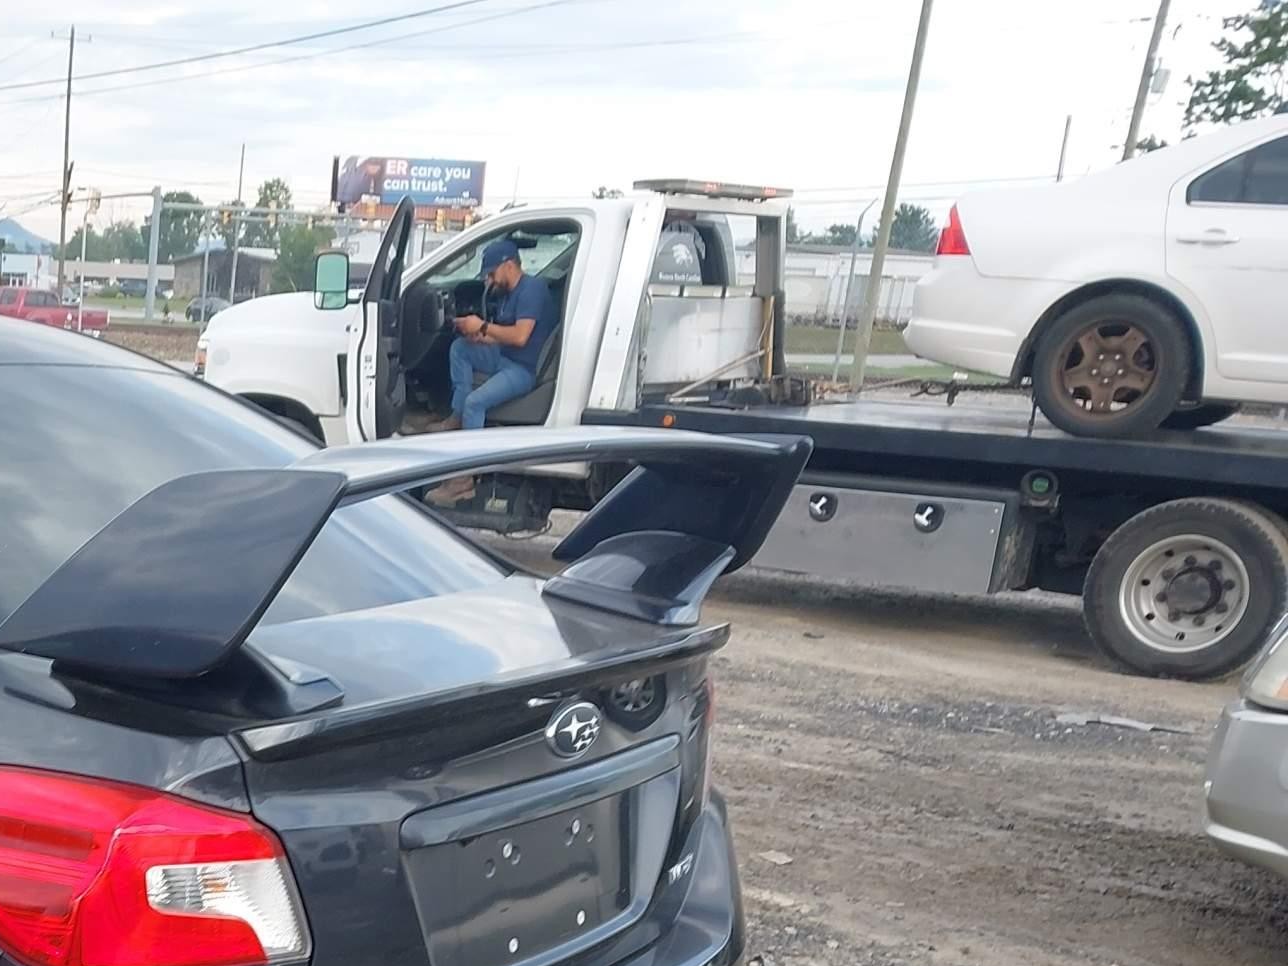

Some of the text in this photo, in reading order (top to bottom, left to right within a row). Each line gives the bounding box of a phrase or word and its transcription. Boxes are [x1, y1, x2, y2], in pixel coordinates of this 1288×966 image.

[385, 159, 471, 182] ER care you
[383, 177, 447, 193] can trust.
